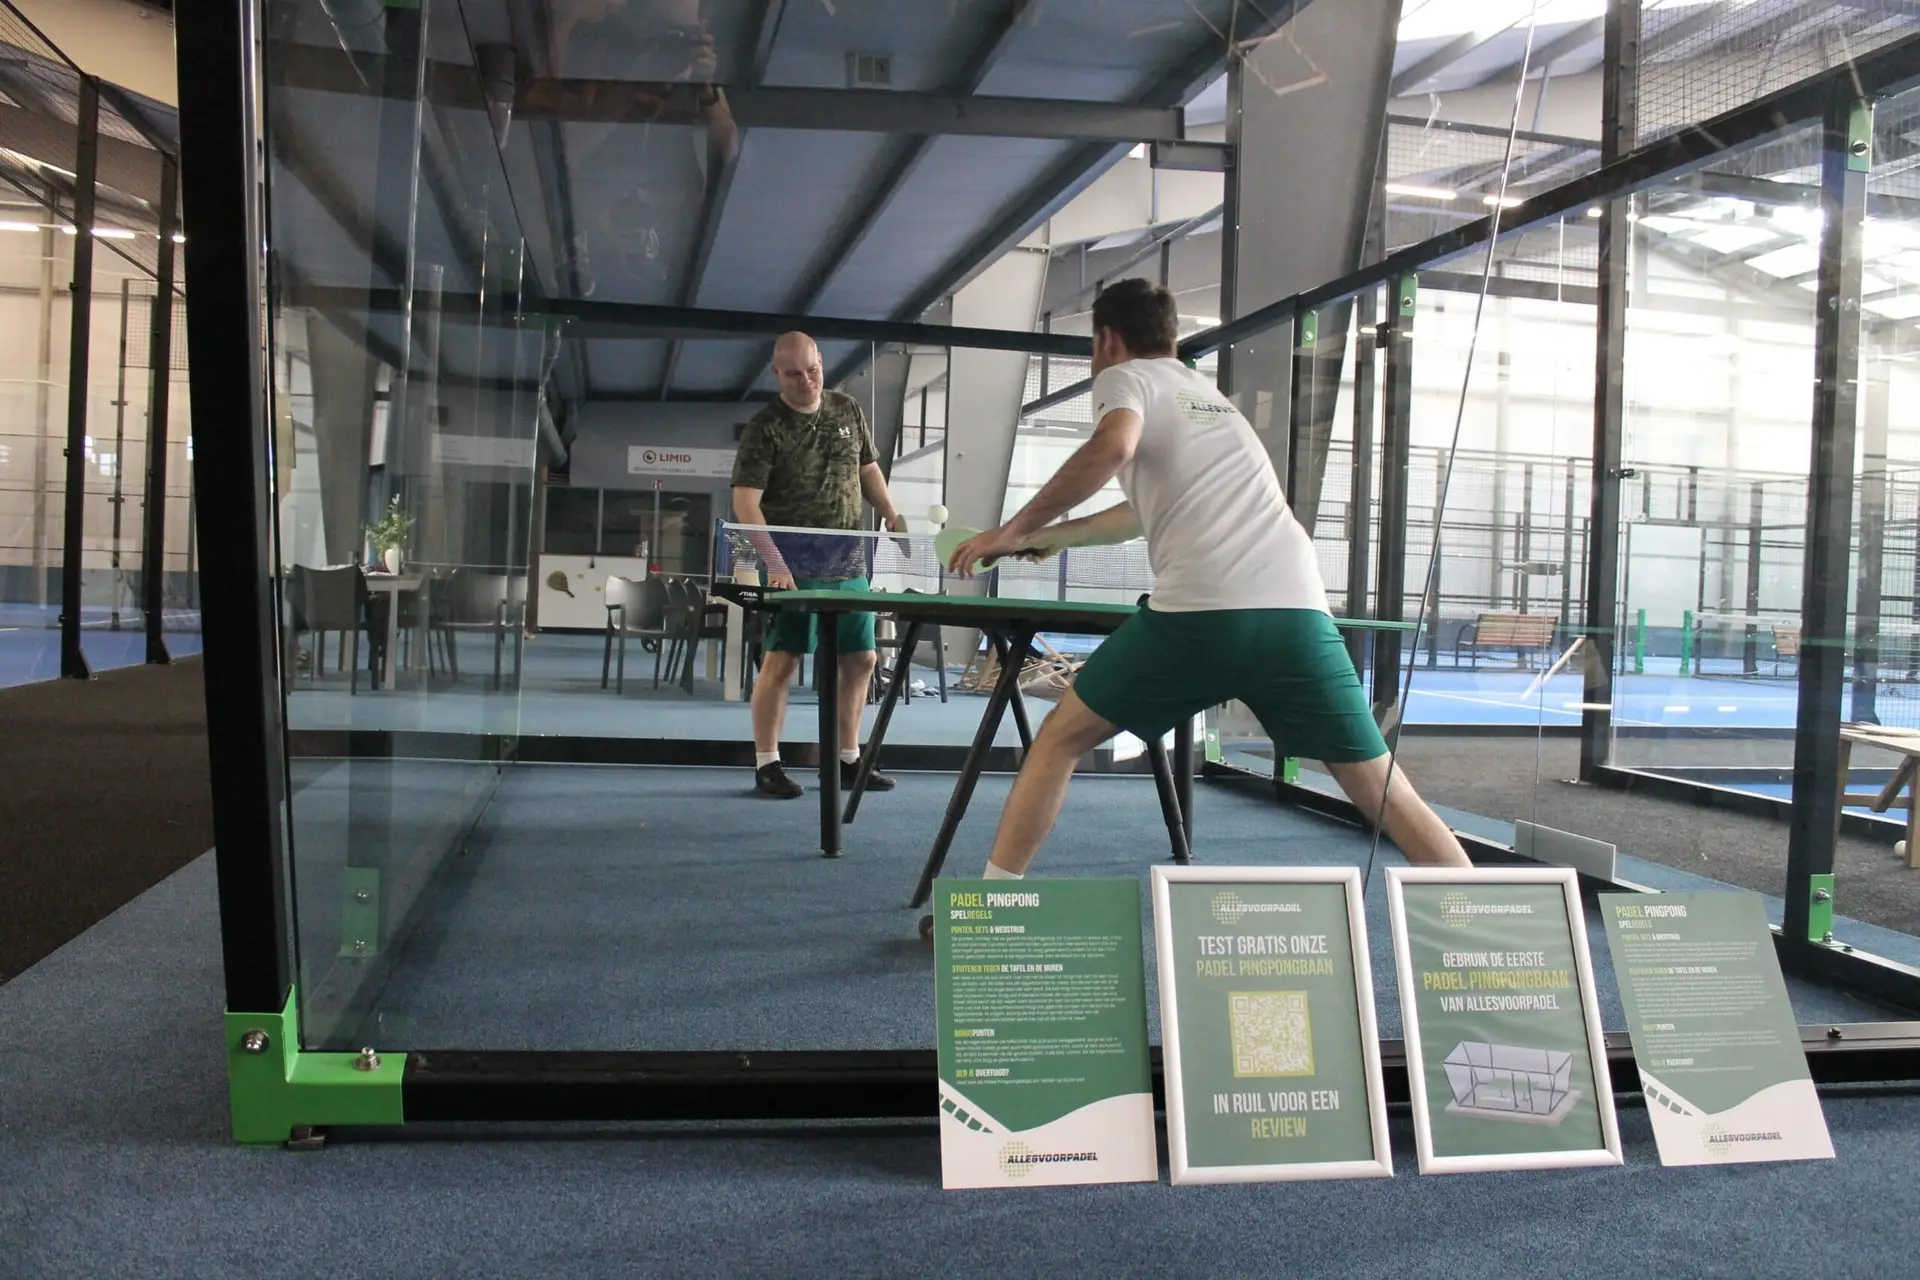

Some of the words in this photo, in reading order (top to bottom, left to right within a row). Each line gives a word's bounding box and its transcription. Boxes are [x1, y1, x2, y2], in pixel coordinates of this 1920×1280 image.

[659, 453, 692, 462] LIMID
[950, 893, 984, 907] PADEL
[986, 893, 1040, 907] PINGPONG
[1220, 903, 1302, 913] ALLESVOORPADEL
[1449, 905, 1533, 914] ALLESVOORPADEL
[1616, 906, 1644, 918] PADEL
[1644, 905, 1687, 917] PINGPONG
[950, 910, 993, 920] SPELREGELS
[1198, 936, 1233, 956] TEST
[1237, 935, 1287, 955] GRATIS
[1290, 935, 1328, 954] ONZE
[1443, 952, 1489, 968] GEBRUIK
[1491, 952, 1504, 967] DE
[1506, 951, 1546, 967] EERSTE
[1001, 964, 1009, 972] DE
[1010, 964, 1026, 972] TAFEL
[1035, 964, 1043, 972] DE
[1196, 959, 1236, 977] PADEL
[1239, 958, 1333, 976] PINGPONGBAAN
[1423, 972, 1468, 990] PADEL
[1469, 970, 1569, 990] PINGPONGBAAN
[1440, 996, 1464, 1012] VAN
[1466, 995, 1559, 1011] ALLESVOORPADEL
[1213, 1093, 1229, 1114] IN
[1233, 1092, 1266, 1113] RUIL
[1268, 1091, 1308, 1112] VOOR
[1311, 1090, 1340, 1111] EEN
[1251, 1117, 1307, 1139] REVIEW
[1709, 1132, 1782, 1143] ALLESVOORPADEL
[1007, 1152, 1098, 1164] ALLESVOORPADEL
